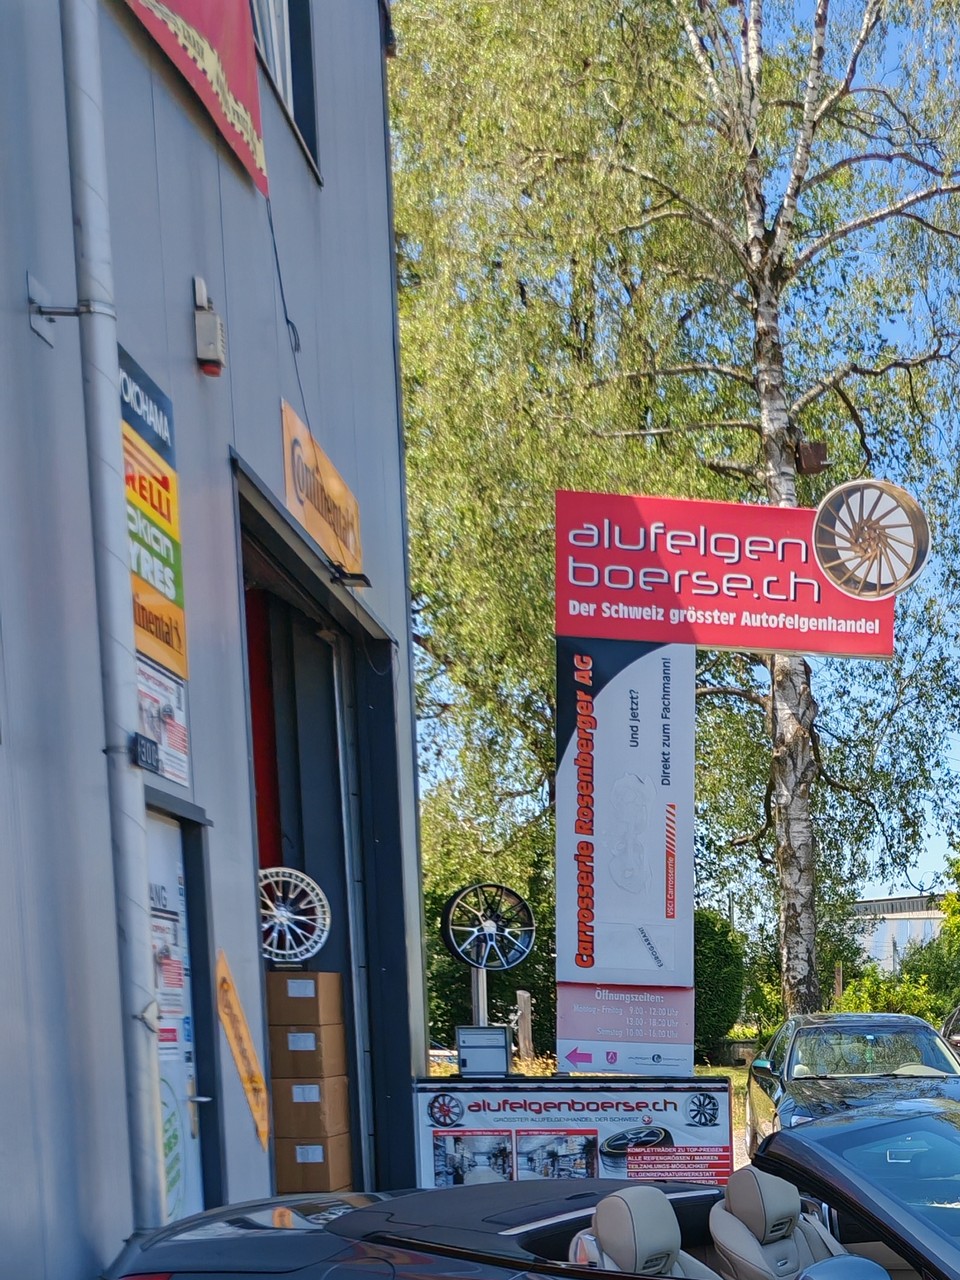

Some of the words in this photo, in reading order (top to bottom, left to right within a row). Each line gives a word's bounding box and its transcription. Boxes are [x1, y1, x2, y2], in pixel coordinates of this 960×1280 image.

[125, 474, 172, 526] RELLI
[568, 518, 808, 564] alufelgen
[568, 556, 822, 603] boerse.ch
[568, 599, 596, 616] Der
[601, 602, 665, 621] Schweiz
[669, 605, 736, 626] grösster
[740, 610, 880, 635] Autofelgenhandel
[573, 653, 594, 687] AG
[660, 657, 672, 721] Fachmann!
[629, 725, 640, 749] Und
[661, 723, 671, 749] zum
[573, 690, 598, 837] Rosenberger
[660, 751, 671, 787] Direkt
[574, 840, 595, 969] Carrosserie
[467, 1099, 678, 1114] alufelgenboerse.ch
